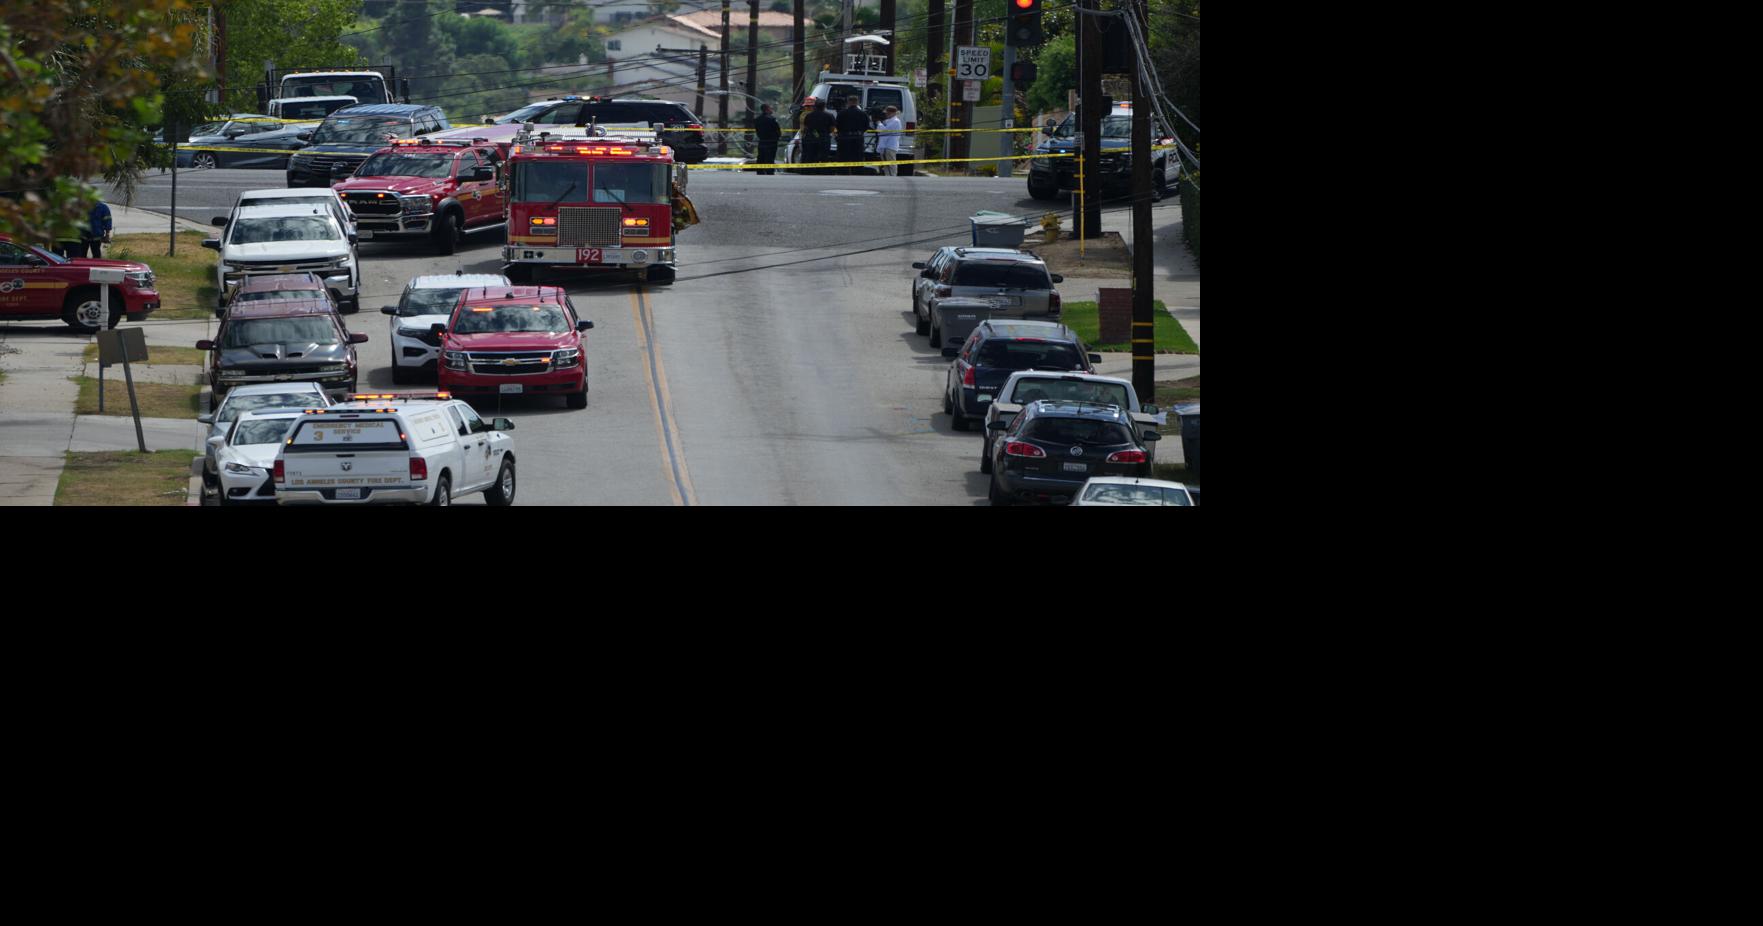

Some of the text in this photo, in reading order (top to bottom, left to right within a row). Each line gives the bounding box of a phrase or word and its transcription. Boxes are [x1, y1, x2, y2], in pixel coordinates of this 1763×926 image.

[961, 64, 987, 76] 30
[578, 249, 600, 261] 192
[313, 431, 324, 441] 3
